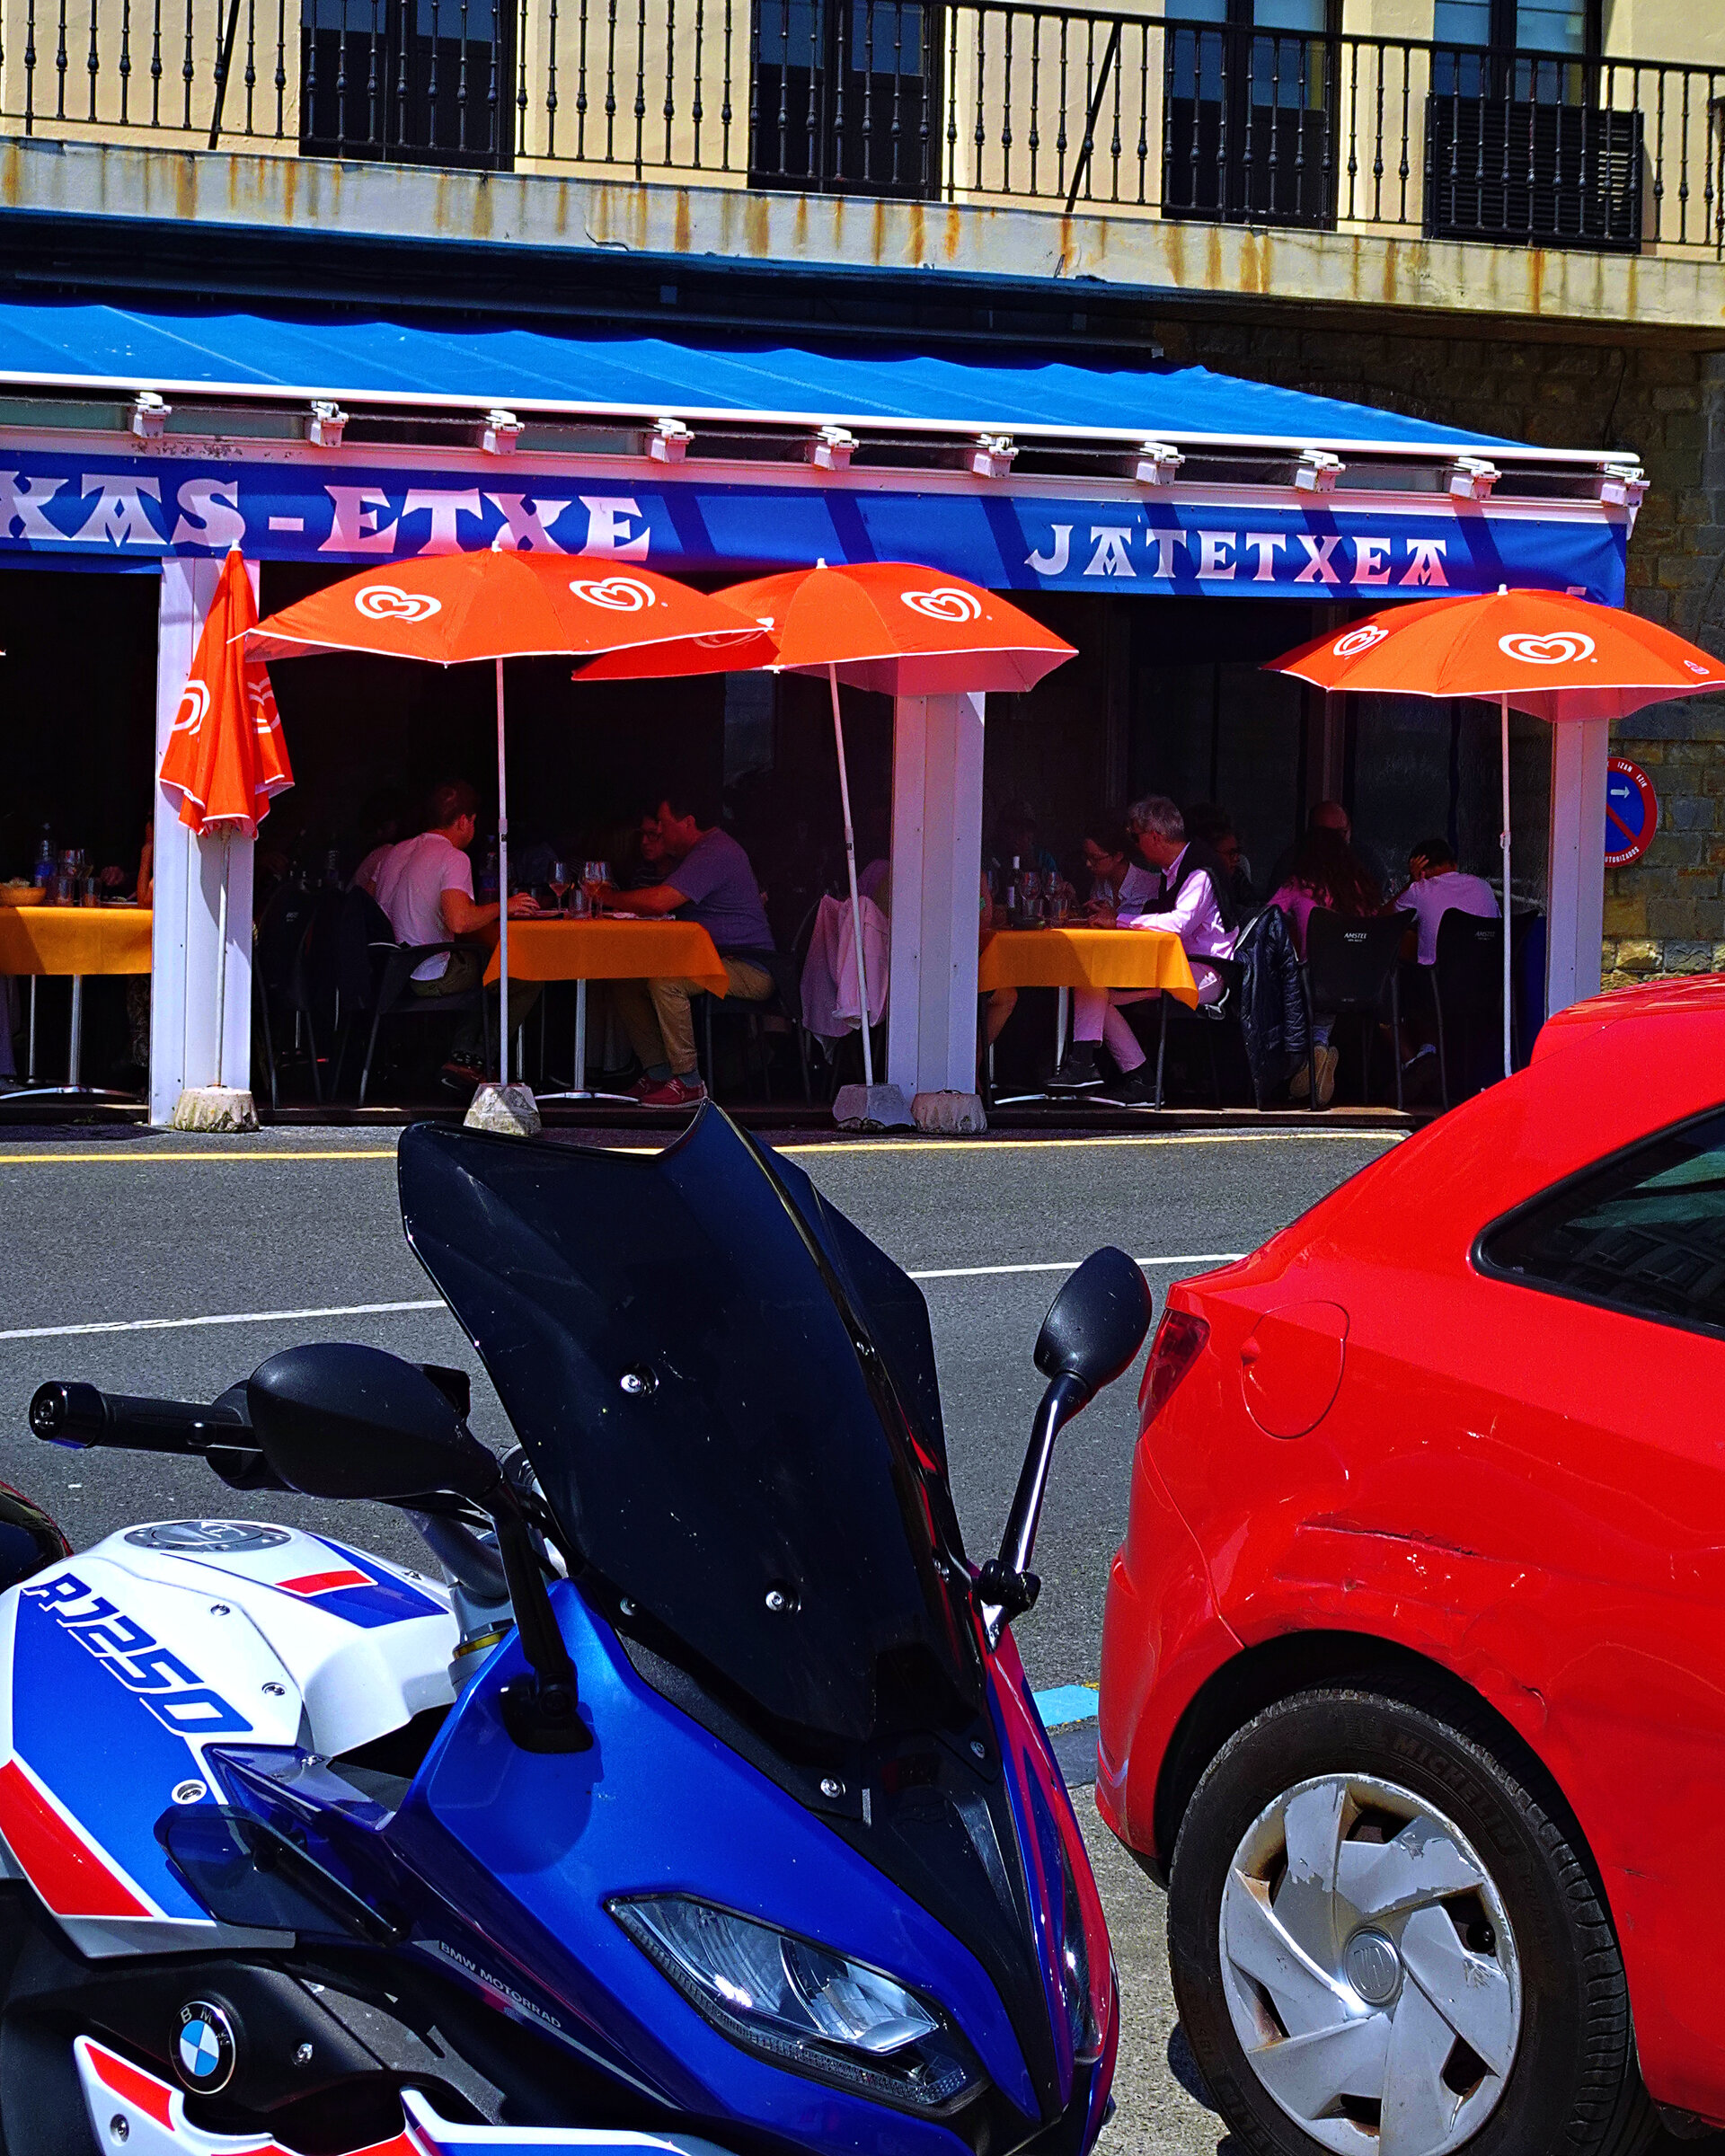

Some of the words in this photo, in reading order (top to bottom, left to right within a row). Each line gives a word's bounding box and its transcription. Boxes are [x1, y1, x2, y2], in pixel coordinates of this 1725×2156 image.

[1024, 524, 1449, 587] JATETXEA
[1617, 761, 1633, 773] IZAN
[1636, 773, 1648, 788] EZIK
[1604, 846, 1640, 862] UTORIZADOS
[22, 1572, 254, 1736] R1250
[1392, 1732, 1520, 1854] MICHELIN
[440, 1941, 475, 1971] BMW
[480, 1968, 562, 2028] MOTORRAD
